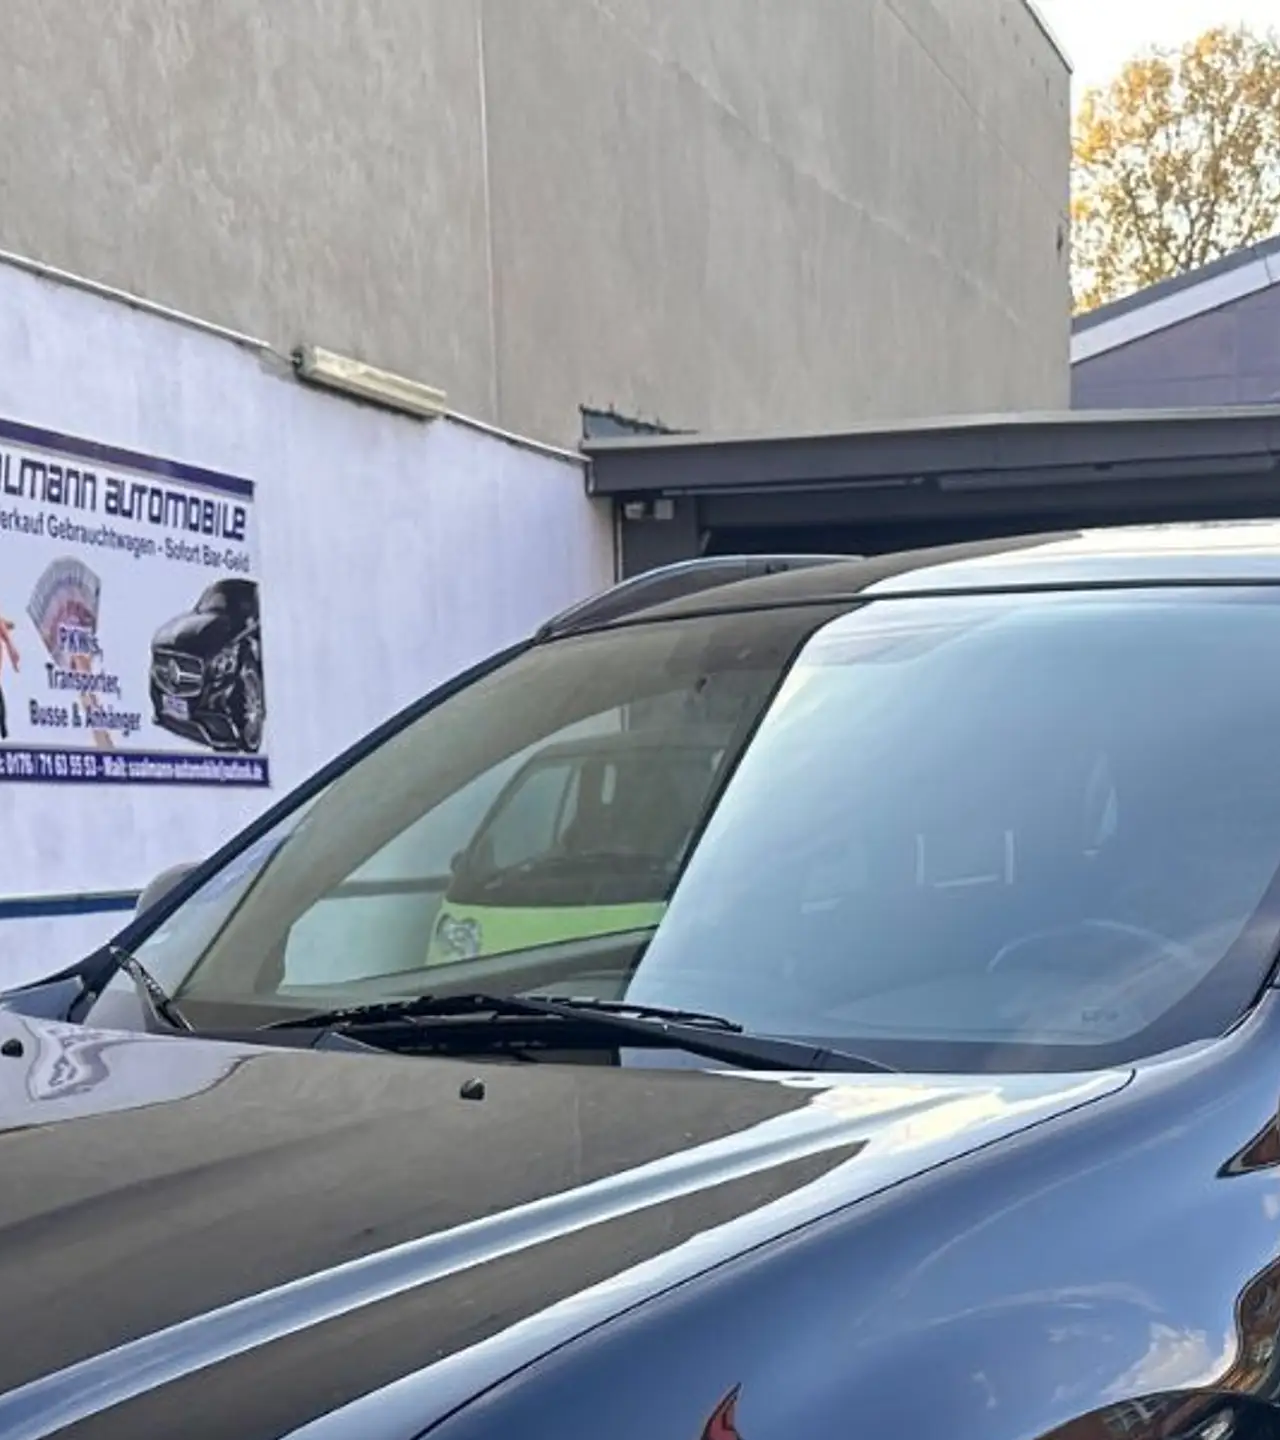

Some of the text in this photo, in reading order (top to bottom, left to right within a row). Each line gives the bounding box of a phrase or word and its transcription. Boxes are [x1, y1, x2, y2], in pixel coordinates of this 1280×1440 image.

[47, 513, 156, 559] Gebrauchtwagen
[165, 537, 200, 564] Sofort
[203, 543, 250, 573] Bar-Geld
[45, 662, 122, 700] Transporter,
[30, 698, 68, 727] Busse
[85, 704, 141, 738] Anhänger
